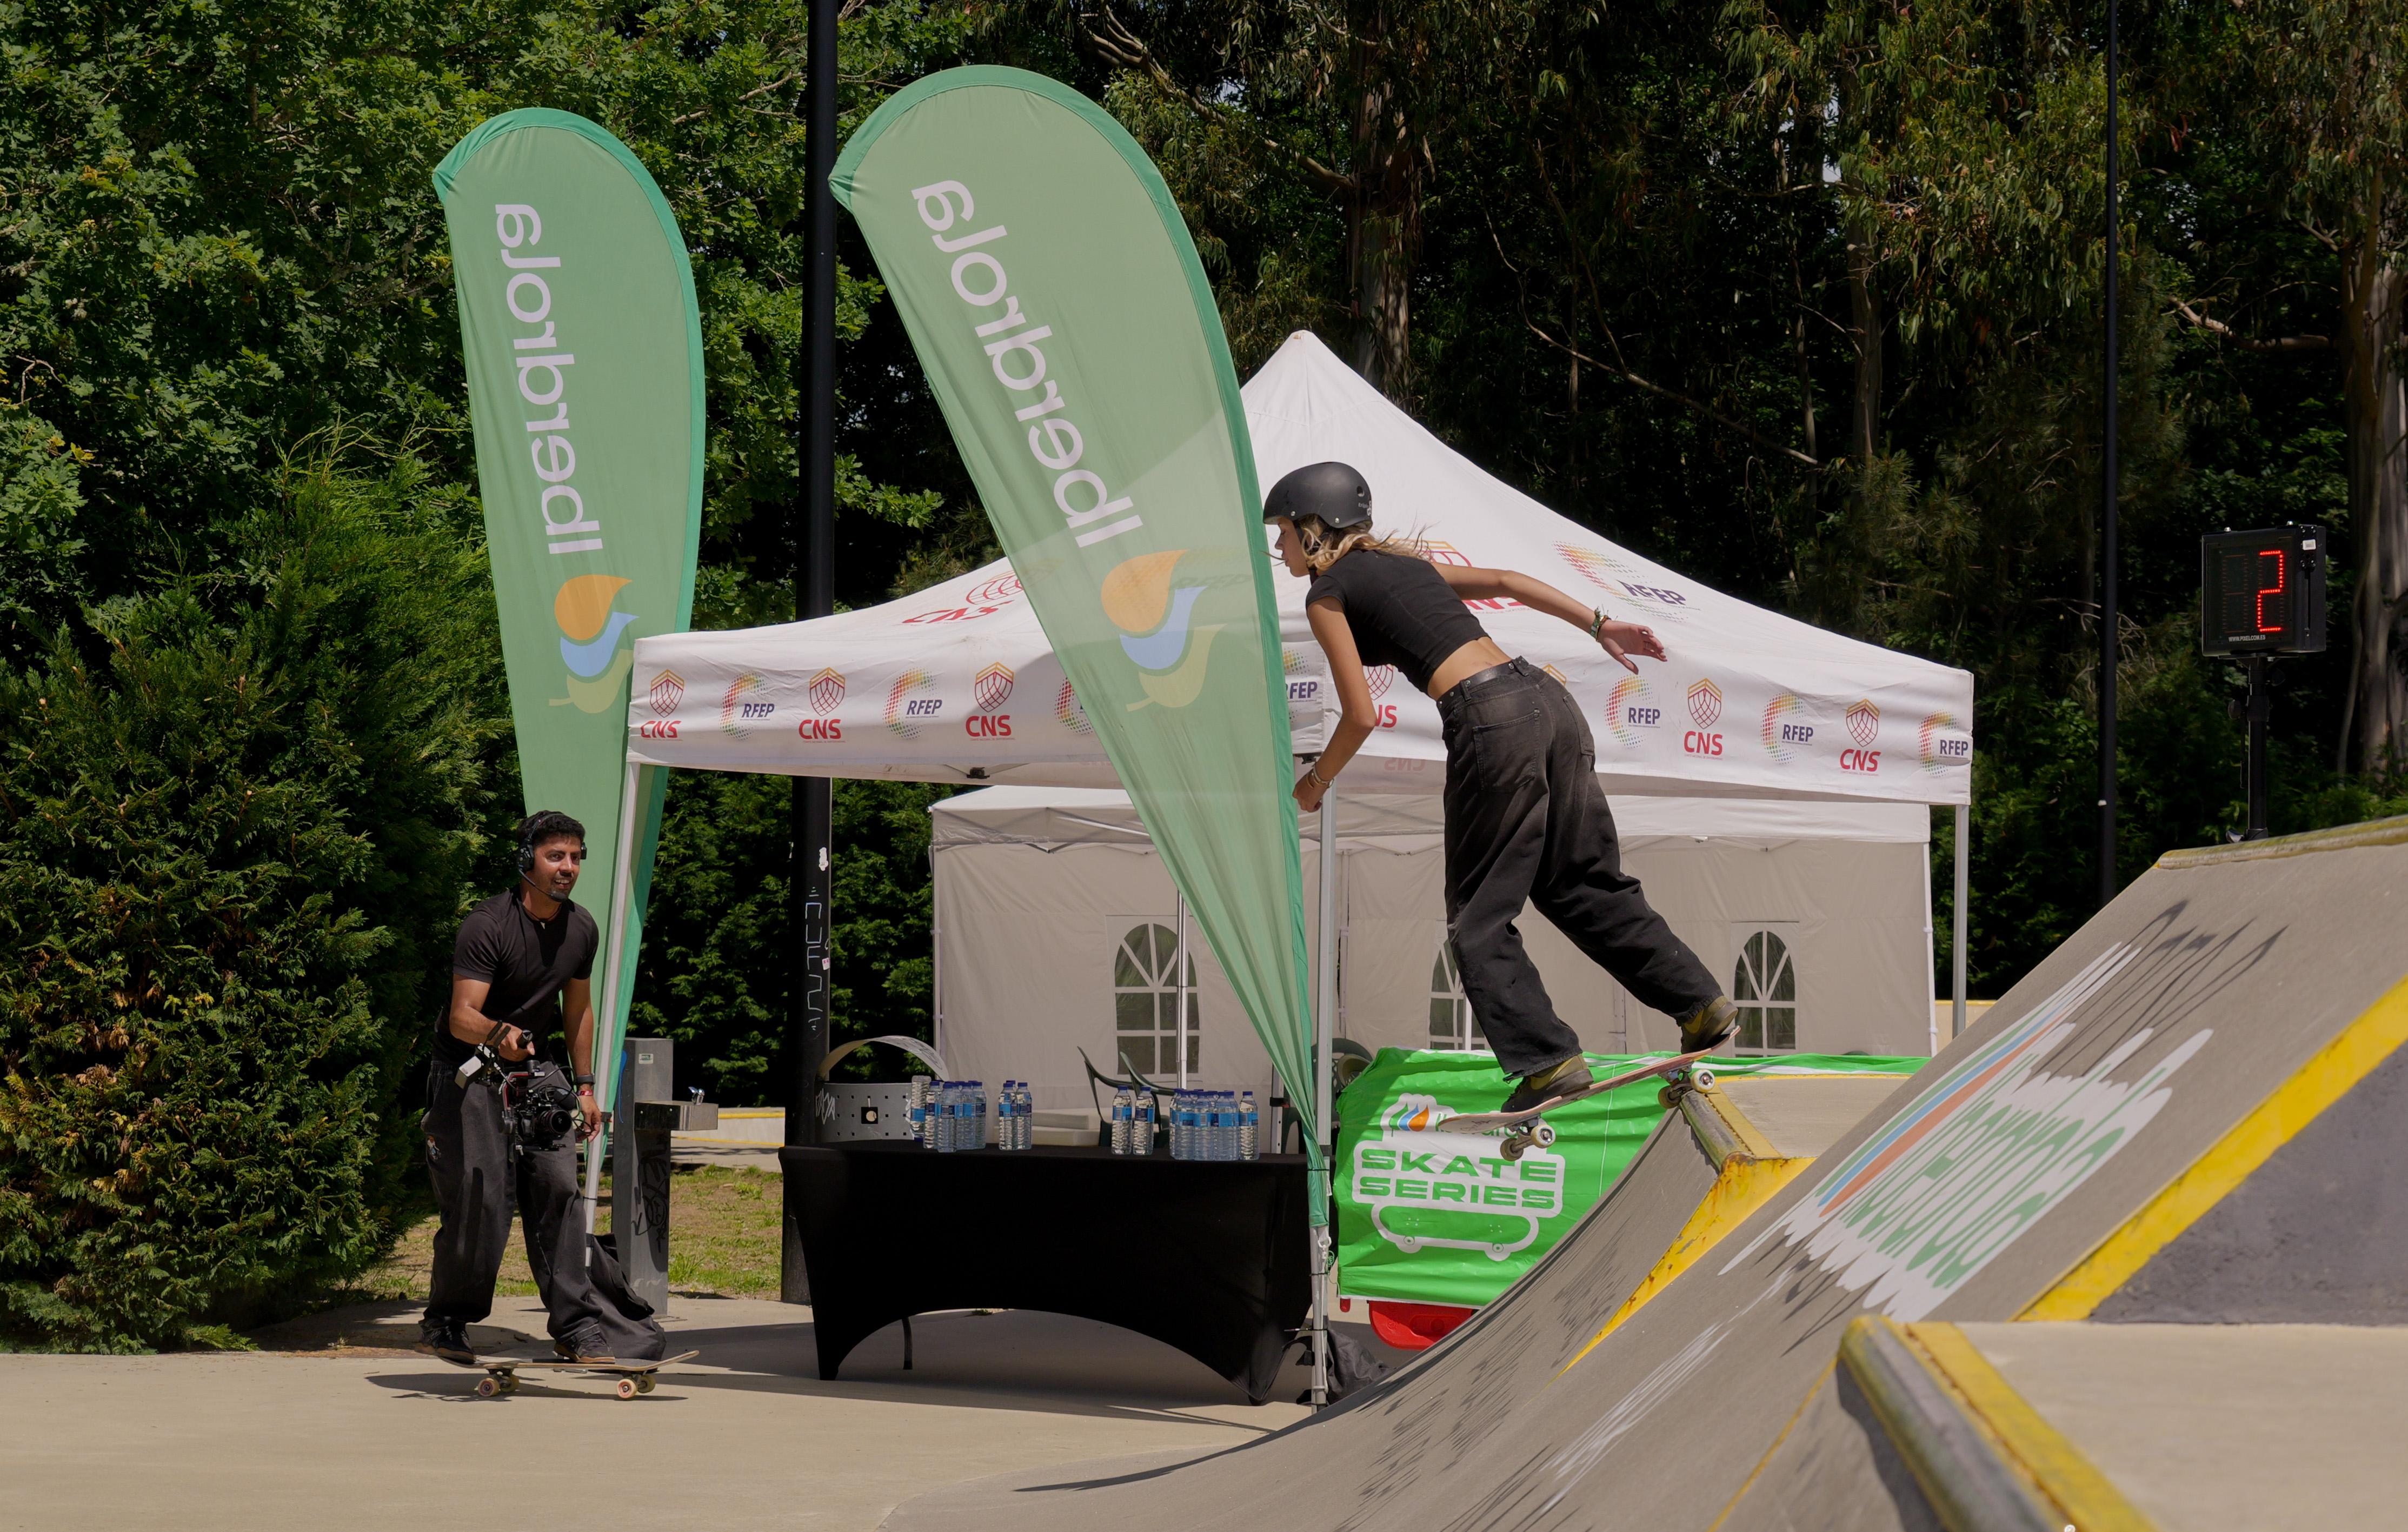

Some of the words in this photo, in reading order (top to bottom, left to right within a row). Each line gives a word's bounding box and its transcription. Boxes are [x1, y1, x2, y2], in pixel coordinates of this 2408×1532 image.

[1615, 579, 1686, 605] RFEP
[2256, 549, 2284, 632] 2
[902, 600, 1015, 623] CNS
[741, 703, 775, 718] RFEP
[906, 700, 943, 715] RFEP
[1628, 707, 1661, 724] RFEP
[640, 721, 682, 738] CNS
[799, 718, 841, 740] CNS
[965, 715, 1012, 737] CNS
[1782, 724, 1813, 742] RFEP
[1684, 731, 1723, 756] CNS
[1940, 739, 1968, 756] RFEP
[1840, 748, 1881, 772] CNS
[1361, 1148, 1557, 1183] SKATE
[1360, 1176, 1555, 1210] SERIES
